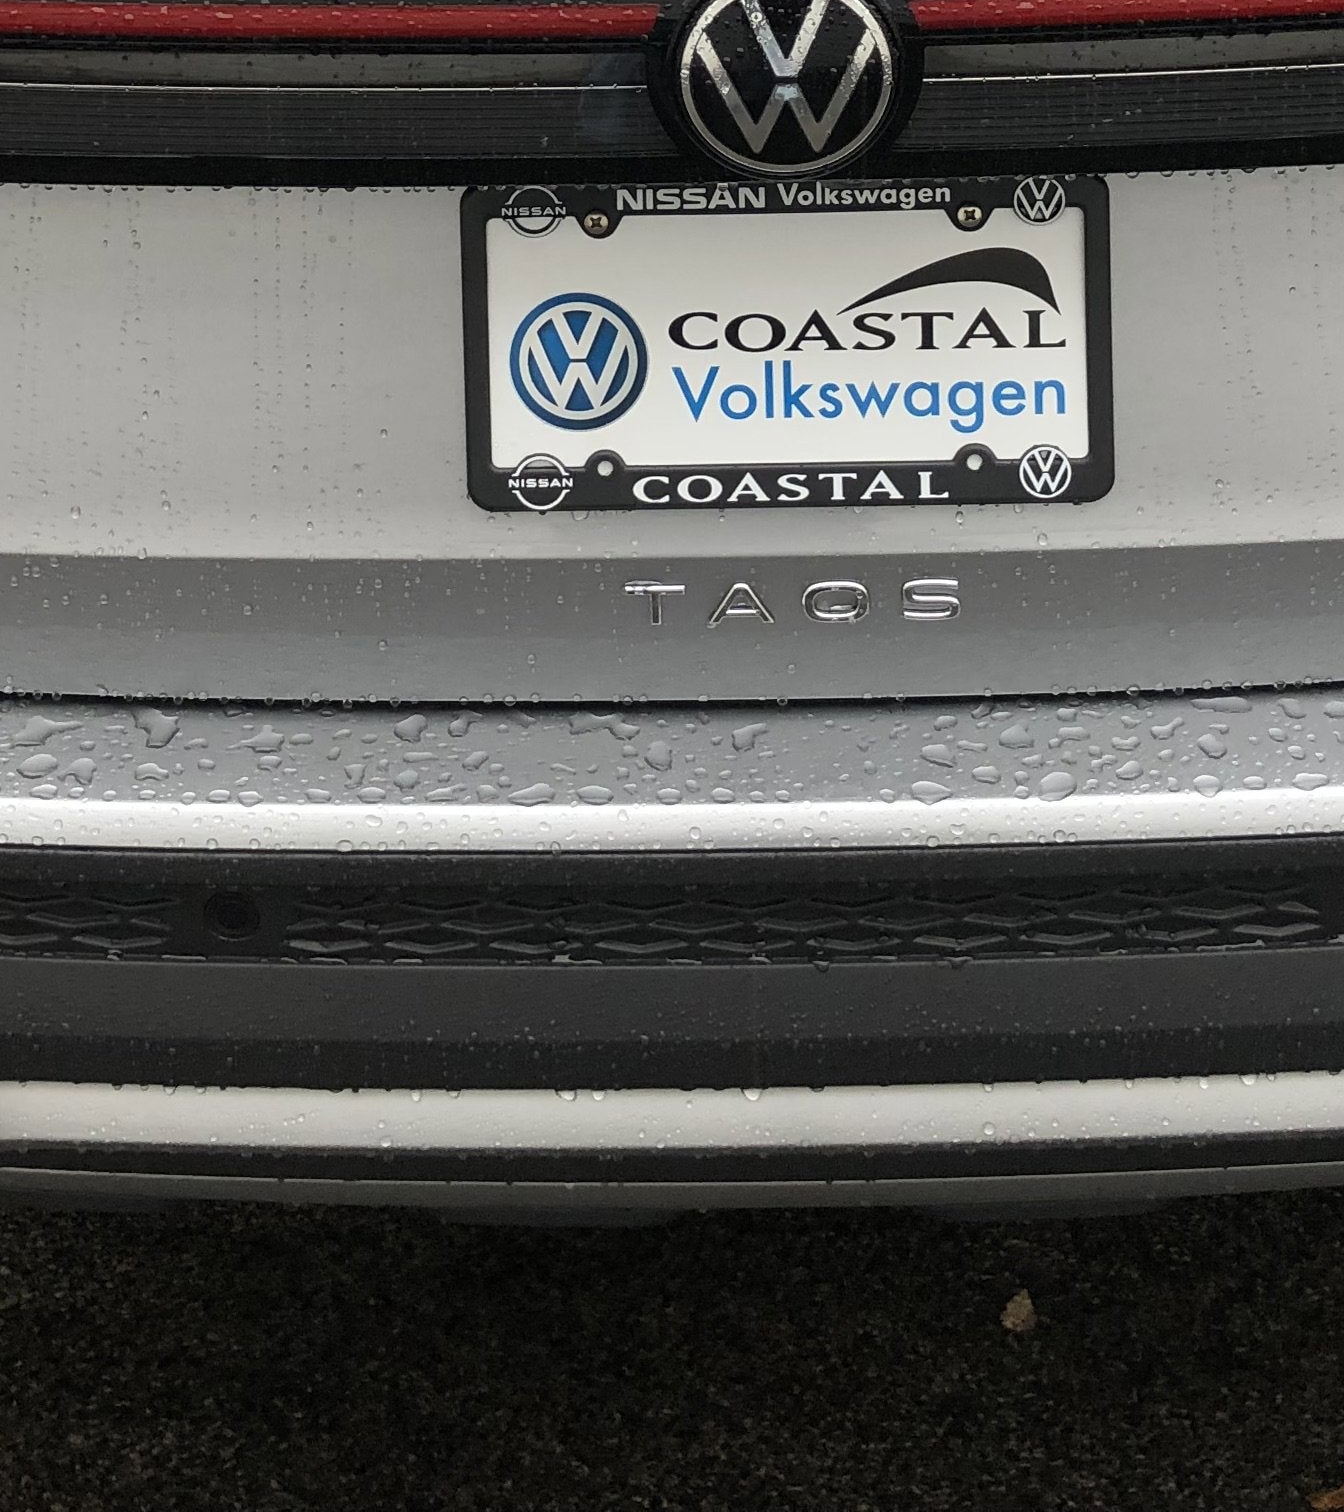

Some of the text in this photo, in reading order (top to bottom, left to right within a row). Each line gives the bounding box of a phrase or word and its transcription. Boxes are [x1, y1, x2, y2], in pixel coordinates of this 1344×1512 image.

[501, 206, 567, 217] NISSAN
[616, 181, 951, 211] NISSAN Volkswagen
[668, 308, 1067, 353] COASTAL
[672, 360, 1067, 433] Volkswagen
[508, 478, 574, 488] NISSAN
[633, 470, 949, 504] COASTAL
[624, 580, 961, 625] TAOS
